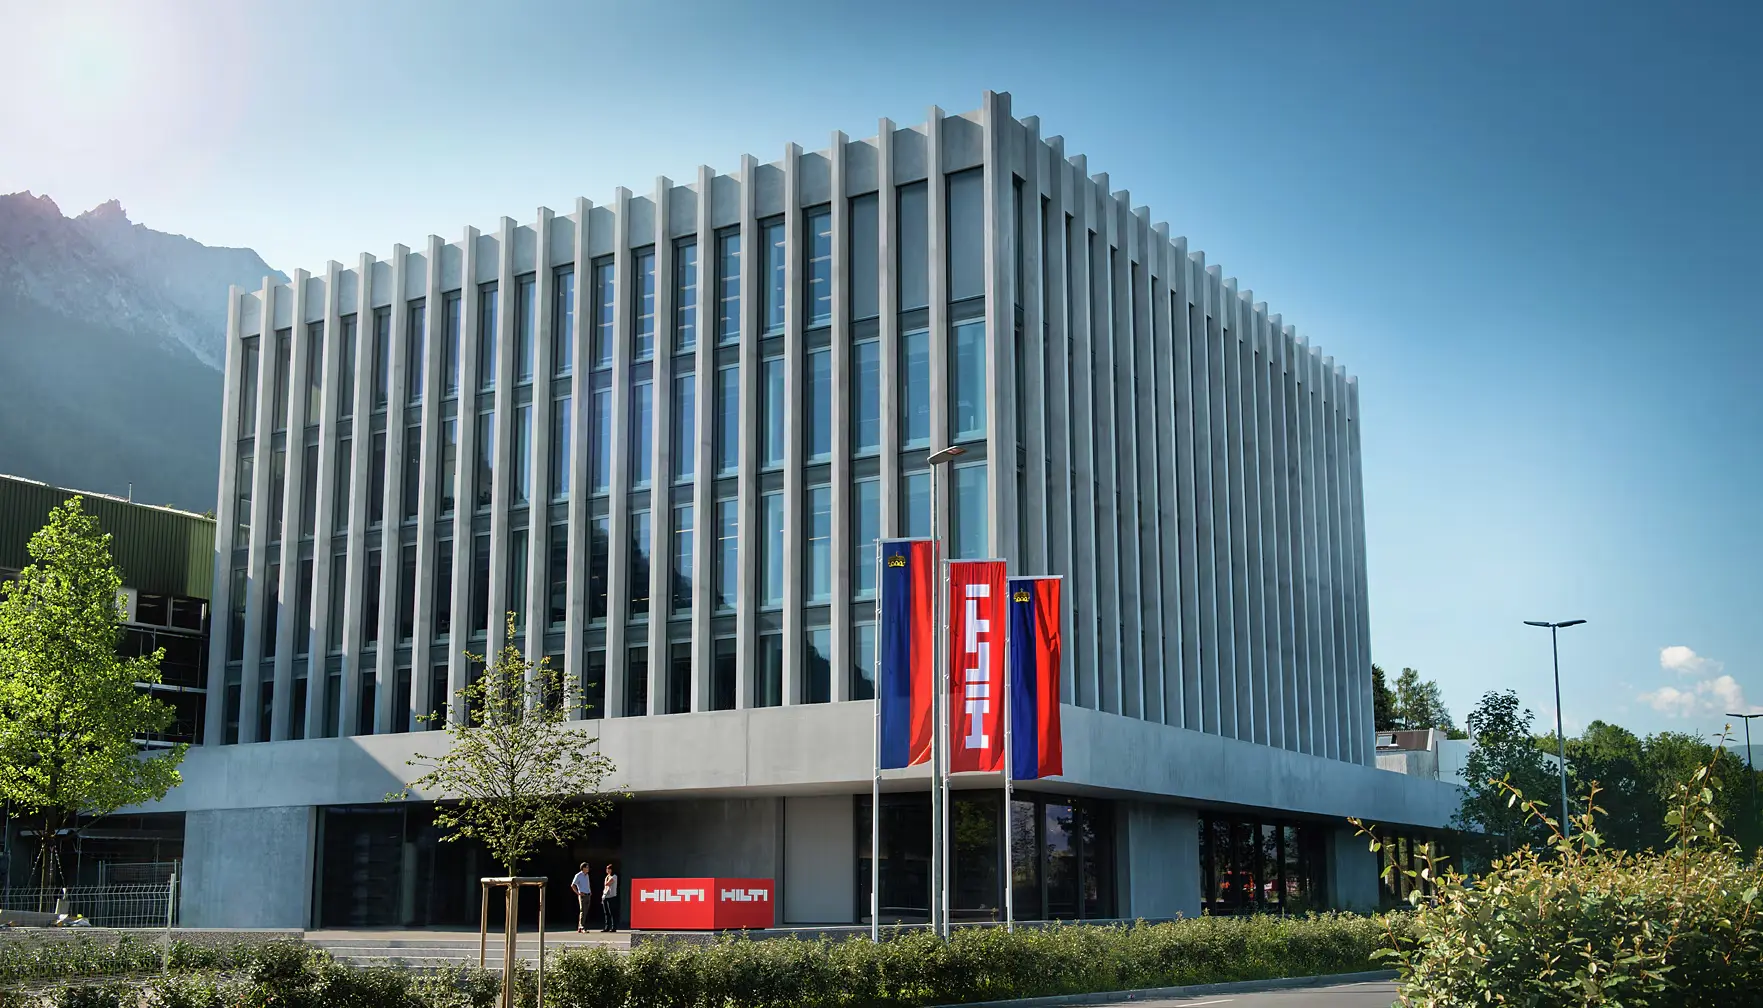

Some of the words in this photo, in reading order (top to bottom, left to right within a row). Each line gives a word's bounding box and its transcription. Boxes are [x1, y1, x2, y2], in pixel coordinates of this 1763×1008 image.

[966, 584, 989, 749] HILTI
[640, 888, 705, 902] HILTI
[721, 888, 768, 902] HILTI
